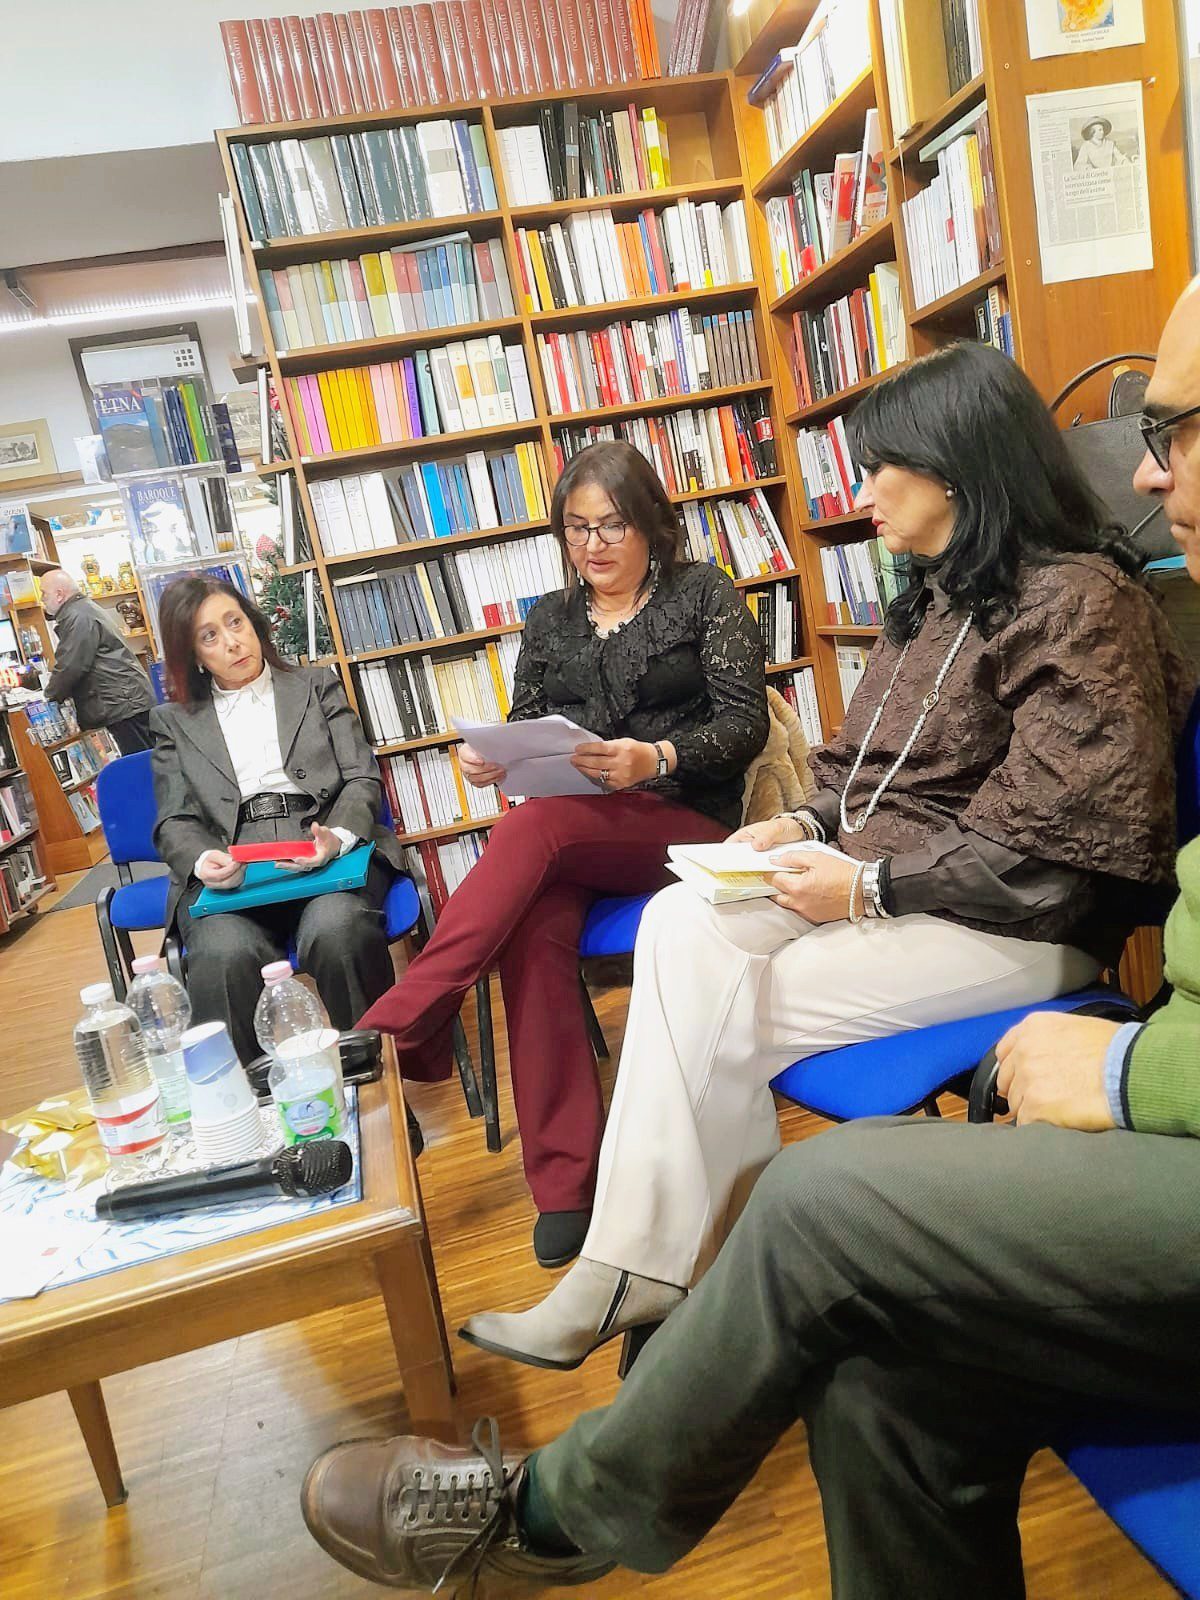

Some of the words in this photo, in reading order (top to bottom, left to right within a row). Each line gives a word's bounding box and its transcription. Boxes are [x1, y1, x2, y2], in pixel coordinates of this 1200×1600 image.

[473, 15, 481, 40] PASCAL
[532, 9, 541, 39] SOCRATE
[548, 7, 558, 37] SPINOZA
[566, 5, 578, 51] TOCQUEVILLE
[585, 3, 597, 36] D'AQUINO
[600, 1, 609, 25] WEBER
[617, 0, 629, 52] WITTGENSTEIN
[309, 33, 319, 58] DEWEY
[373, 25, 383, 45] KANT
[423, 20, 437, 63] MONTAIGNE
[440, 17, 452, 56] NIETZSCHE
[455, 15, 465, 49] NEWTON
[515, 11, 529, 68] SCHOPENHAUER
[233, 36, 242, 60] SMITH
[393, 20, 408, 77] KIERKEGAARD
[591, 37, 601, 70] TOMMASO
[990, 293, 1000, 339] UNESCO
[101, 396, 141, 414] ETNA
[137, 486, 176, 502] BAROQUE
[402, 690, 411, 713] NEWTON
